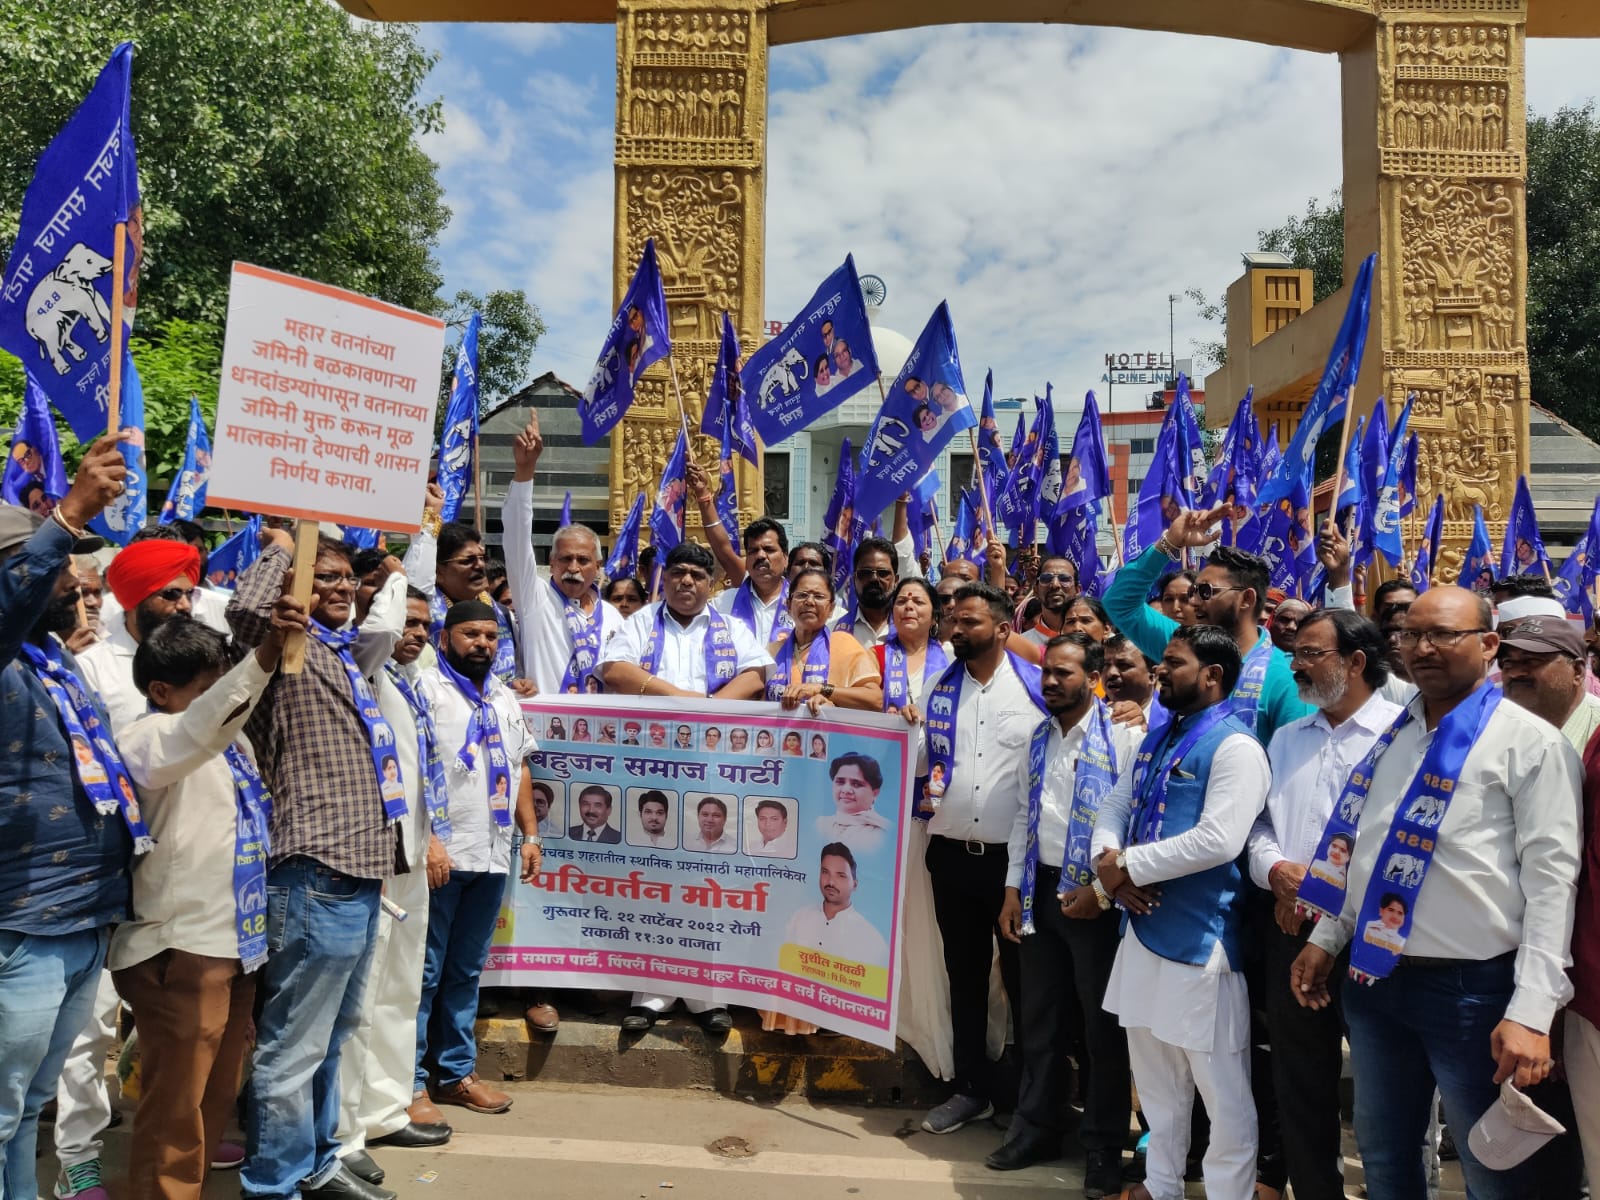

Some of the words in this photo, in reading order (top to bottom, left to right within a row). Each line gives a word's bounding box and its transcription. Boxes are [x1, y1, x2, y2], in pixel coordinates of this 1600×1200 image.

[252, 339, 308, 369] जमिनी
[285, 317, 326, 343] महार
[331, 332, 396, 361] वतनांच्या
[1105, 352, 1170, 367] HOTEL
[1101, 373, 1147, 383] ALPINE
[1151, 373, 1173, 383] INN
[241, 397, 297, 424] जमिनी
[303, 409, 336, 434] मुक्त
[341, 417, 382, 440] करून
[387, 426, 414, 450] मूळ
[226, 424, 308, 455] मालकांना
[313, 434, 370, 466] देण्याची
[375, 452, 420, 474] शासन
[270, 456, 320, 484] निर्णय
[325, 471, 376, 494] करावा.
[530, 750, 615, 779] बहुजन
[624, 756, 708, 782] समाज
[717, 759, 785, 786] पार्टी
[578, 850, 626, 865] शहरातील
[629, 854, 673, 870] स्थानिक
[676, 858, 730, 876] प्रश्नांसाठी
[734, 862, 807, 884] महापालिकेवर
[530, 864, 672, 903] परिवर्तन
[681, 878, 770, 913] मोर्चा
[594, 905, 612, 921] दि.
[617, 912, 635, 923] २२
[639, 912, 684, 929] सप्टेंबर
[687, 918, 725, 934] २०२२
[729, 920, 762, 937] रोजी
[581, 926, 630, 941] सकाळी
[634, 931, 674, 945] ११:३०
[678, 935, 721, 952] वाजता
[798, 950, 830, 968] सुशील
[485, 952, 519, 969] हुजन
[522, 953, 566, 966] समाज
[608, 955, 647, 971] पिंपरी
[650, 958, 699, 978] चिंचवड
[703, 968, 734, 984] शहर
[738, 970, 778, 990] जिल्हा
[782, 978, 792, 992] व
[795, 984, 816, 1001] सर्व
[818, 990, 887, 1023] विधानसभा
